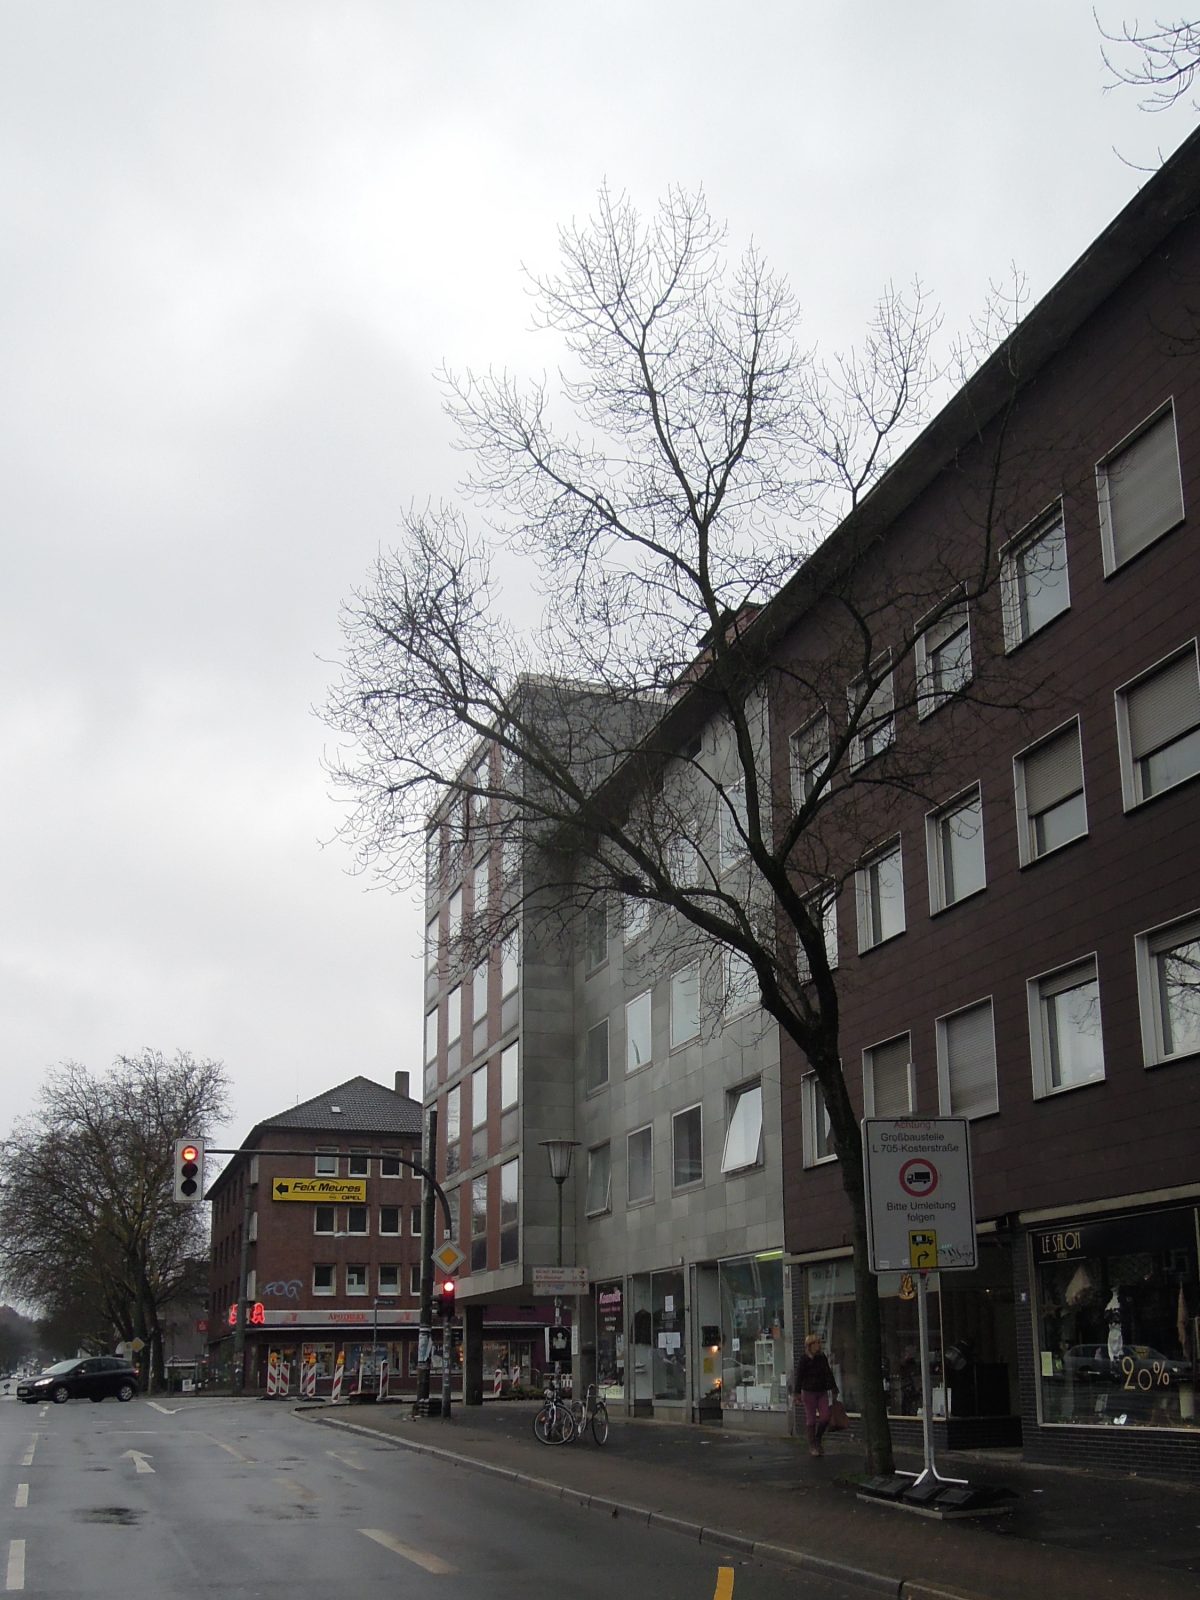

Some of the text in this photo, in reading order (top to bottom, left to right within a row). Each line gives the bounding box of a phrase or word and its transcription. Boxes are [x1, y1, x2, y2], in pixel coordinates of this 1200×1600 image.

[880, 1132, 945, 1142] Großbaustelle
[872, 1144, 879, 1153] L
[318, 1182, 361, 1193] Meures
[887, 1201, 957, 1211] Bitte Umleitung
[907, 1213, 935, 1223] folgen
[1042, 1232, 1081, 1254] LE SALON
[1121, 1356, 1169, 1391] 20%
